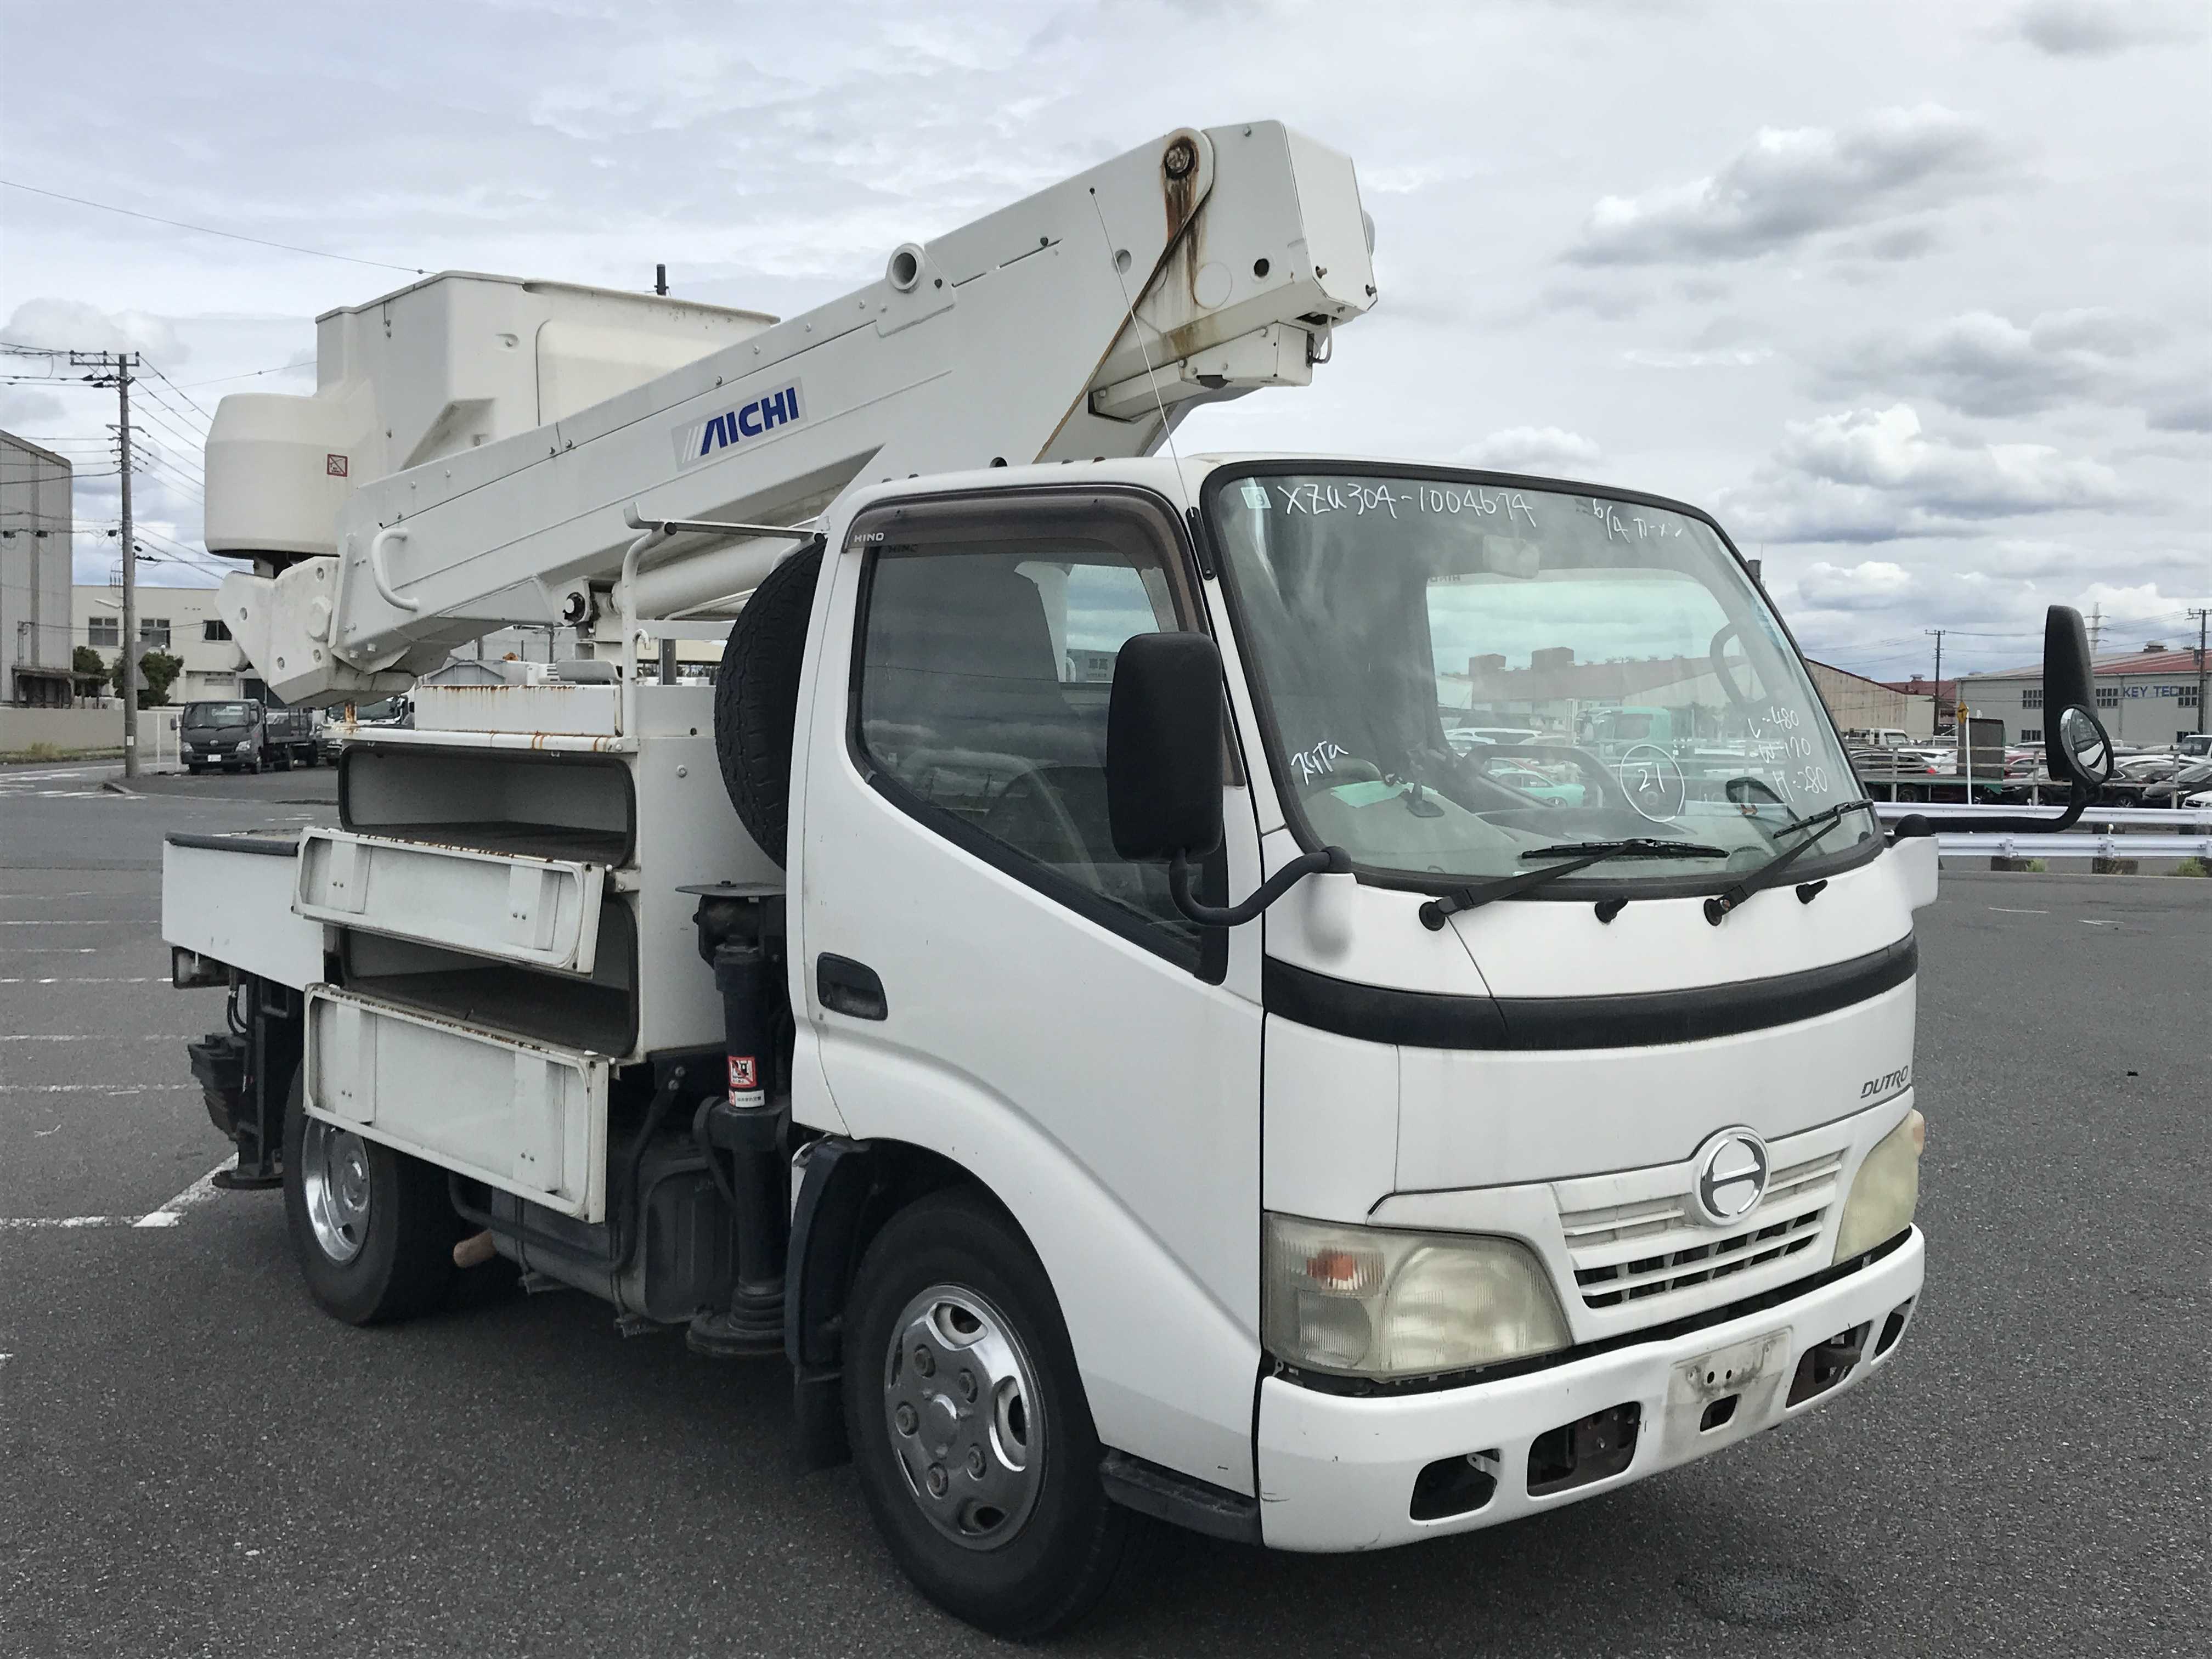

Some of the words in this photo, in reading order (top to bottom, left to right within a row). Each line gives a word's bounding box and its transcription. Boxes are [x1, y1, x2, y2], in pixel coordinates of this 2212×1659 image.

[700, 387, 799, 456] AICHI
[854, 532, 885, 543] HINO
[2123, 686, 2148, 698] KEY
[2153, 685, 2179, 697] TEC
[1637, 763, 1666, 793] 21
[1860, 1065, 1909, 1099] DUTRO
